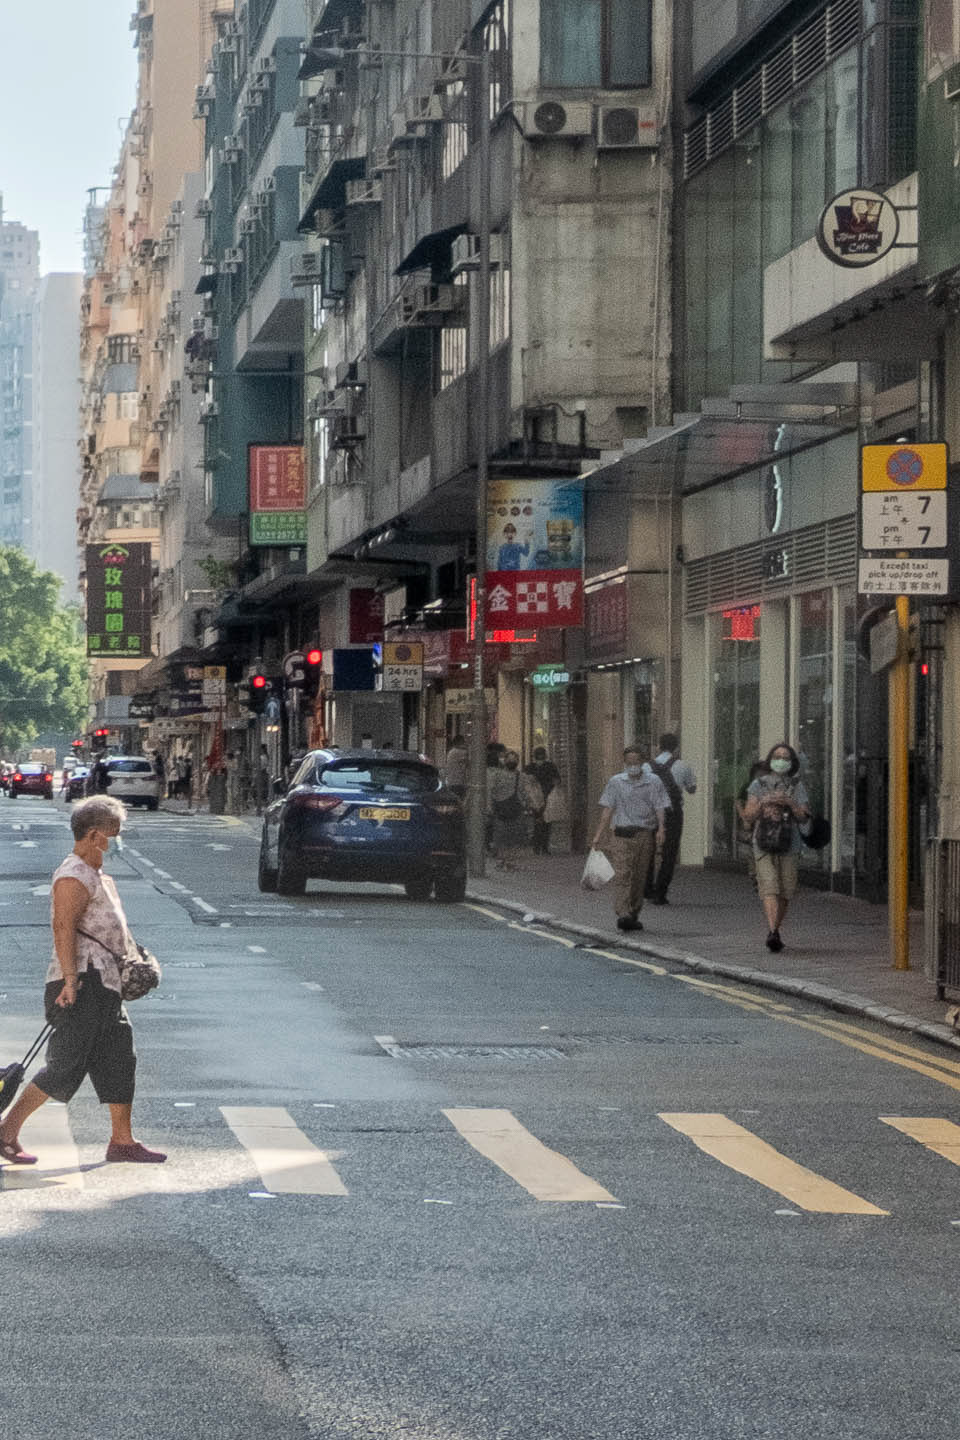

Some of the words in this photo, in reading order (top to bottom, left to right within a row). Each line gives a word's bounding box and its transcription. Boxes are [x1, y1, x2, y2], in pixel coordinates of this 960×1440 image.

[880, 505, 902, 515] 上午
[918, 496, 931, 514] 7
[880, 535, 904, 546] 下午
[918, 526, 931, 544] 7
[880, 562, 910, 570] Except
[488, 584, 512, 611] 金
[388, 667, 400, 676] 24
